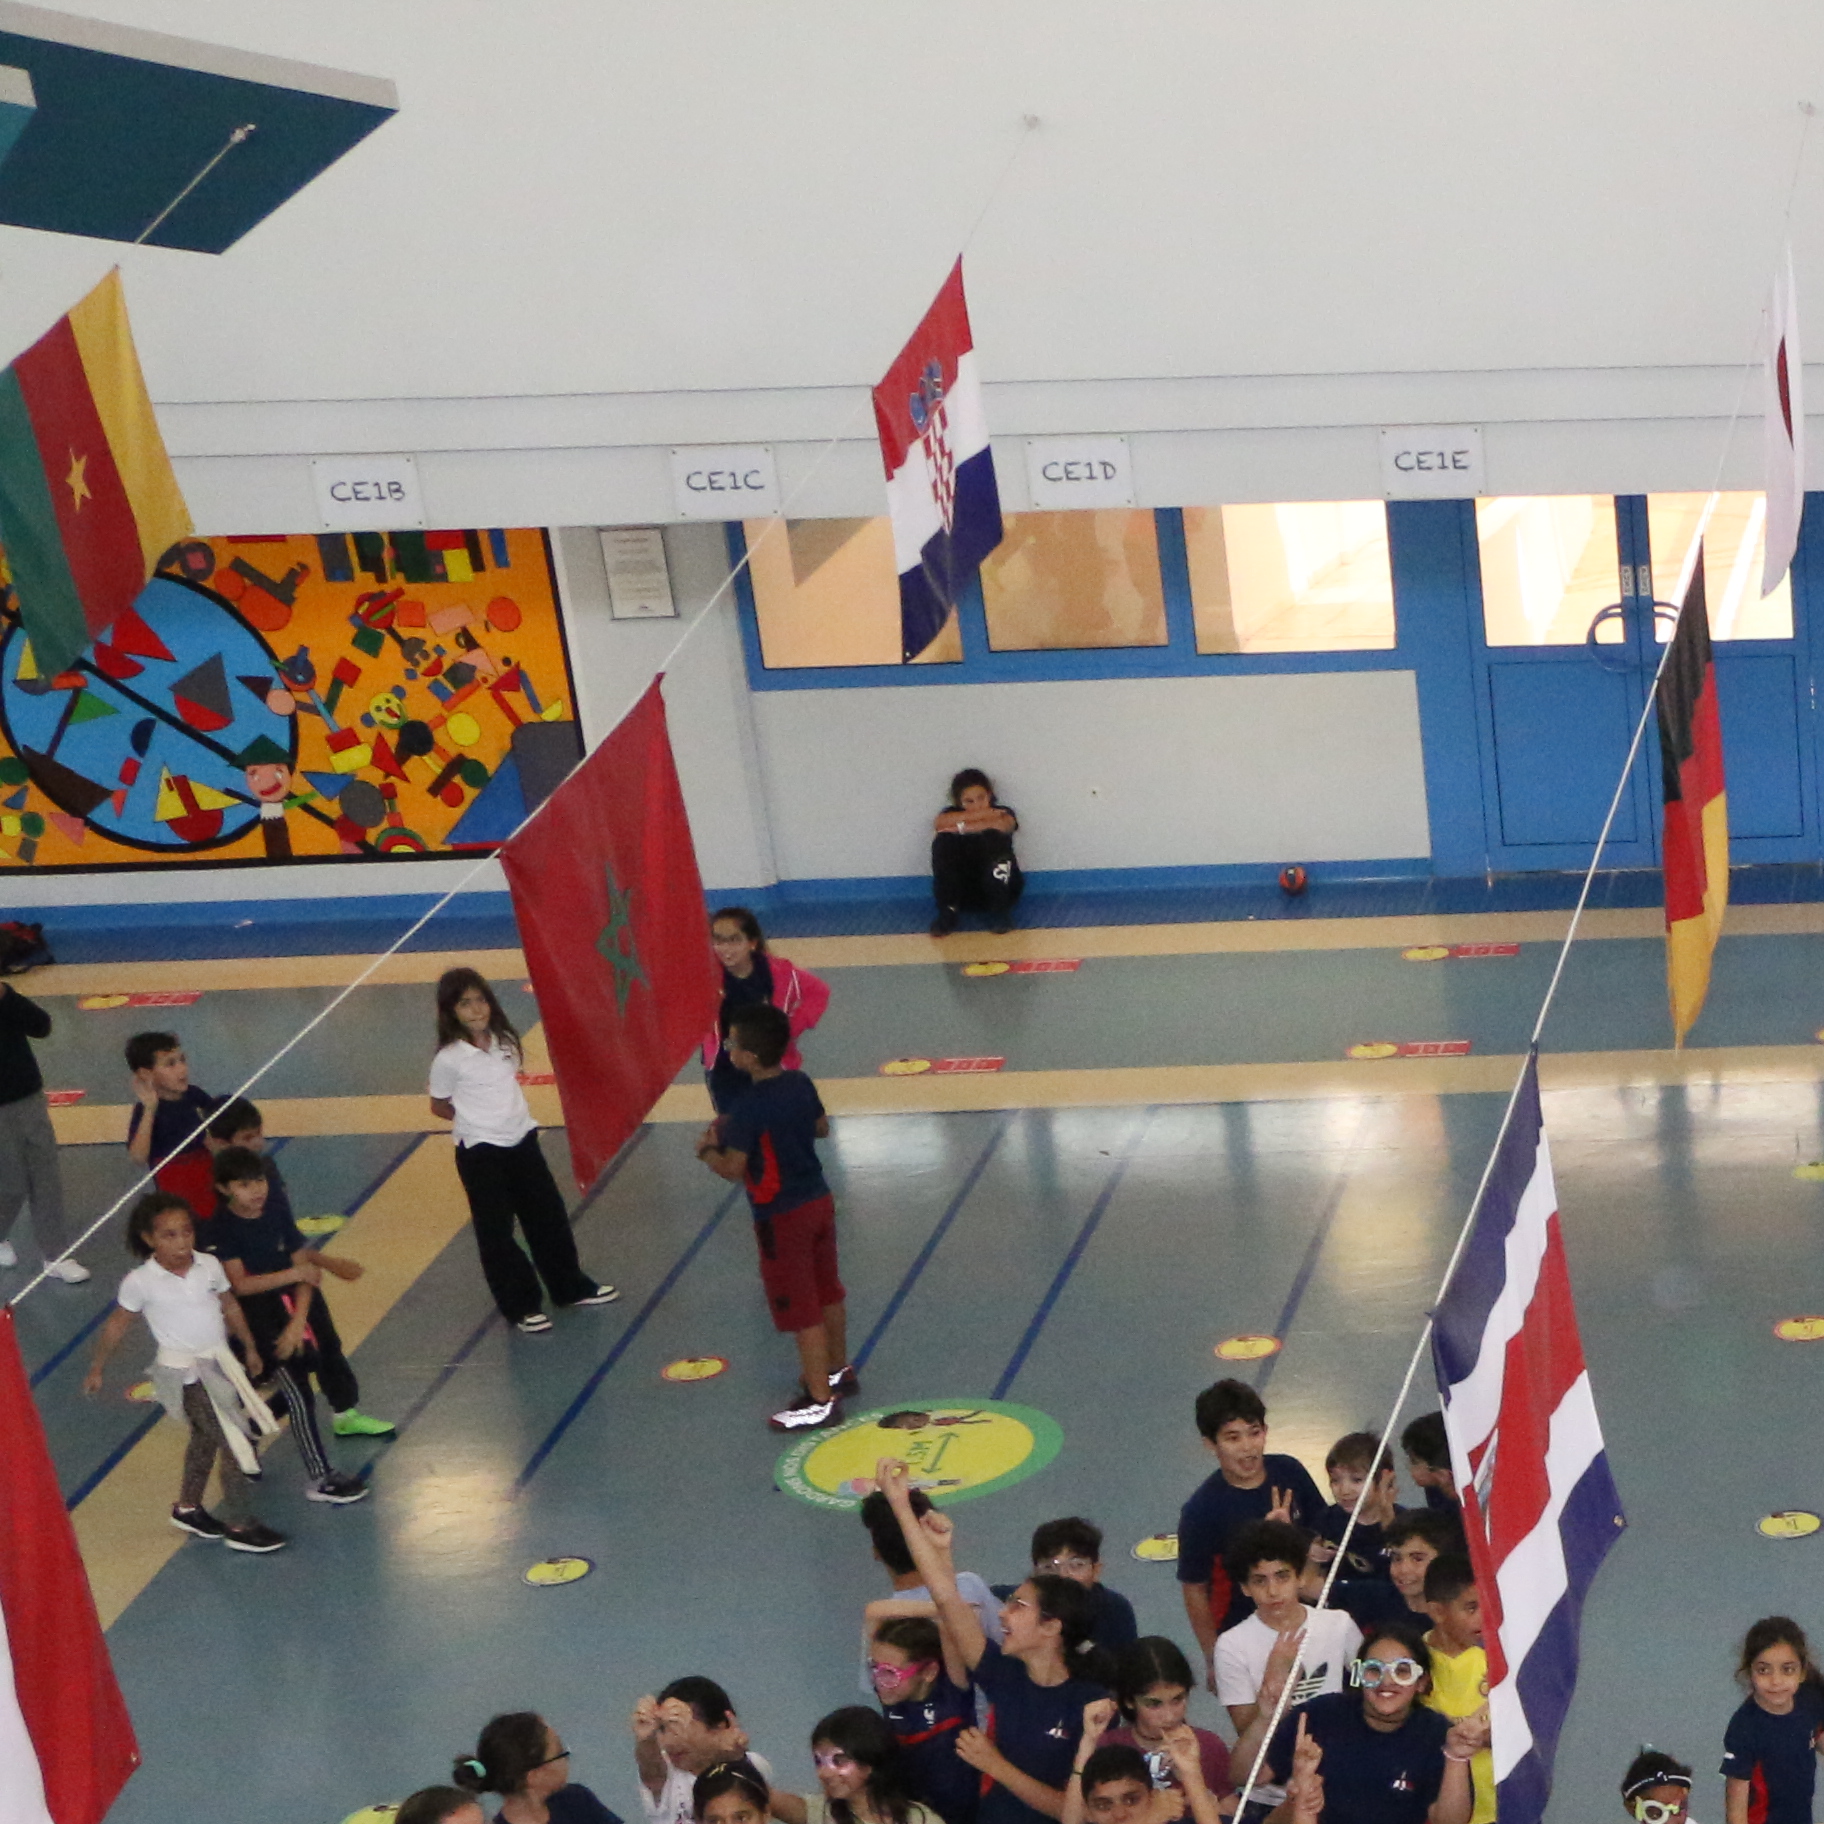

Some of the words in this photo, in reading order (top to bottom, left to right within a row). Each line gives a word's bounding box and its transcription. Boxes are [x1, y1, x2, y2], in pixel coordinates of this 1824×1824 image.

[1394, 450, 1470, 471] CE1E
[686, 469, 765, 491] CE1C
[1042, 461, 1116, 482] CE1D
[330, 481, 406, 501] CE1B
